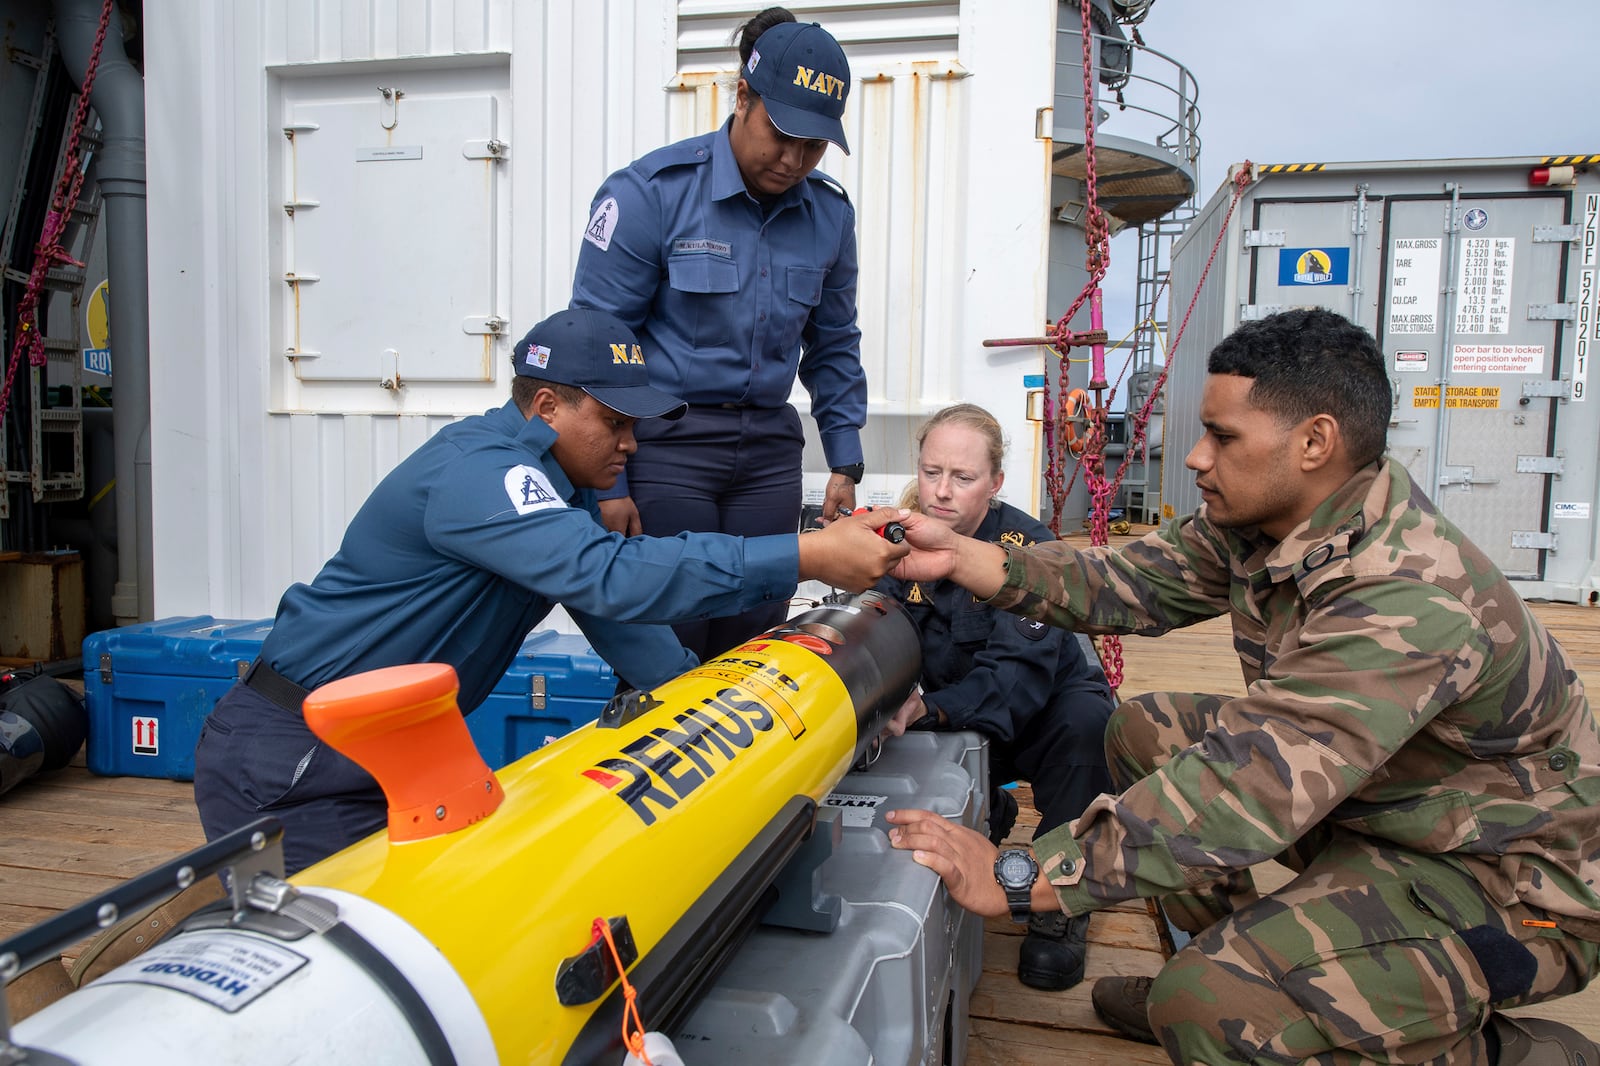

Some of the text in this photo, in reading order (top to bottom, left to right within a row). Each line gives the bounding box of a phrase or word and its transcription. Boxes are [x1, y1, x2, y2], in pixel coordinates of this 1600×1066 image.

[793, 65, 845, 101] NAVY
[1585, 195, 1599, 265] NZDF
[1396, 240, 1438, 249] MAX.GROSS
[1467, 239, 1510, 249] 4.320 kgs.
[1466, 249, 1507, 258] 9.520 lbs.
[1395, 258, 1412, 267] TARE
[1465, 258, 1509, 268] 2.320 kgs.
[1464, 268, 1506, 276] 5.110 lbs.
[1394, 277, 1407, 286] NET
[1464, 277, 1507, 287] 2.000 kgs.
[1463, 286, 1505, 295] 4.410 lbs.
[1469, 296, 1486, 304] 13.5
[1462, 305, 1485, 314] 476.7
[1392, 314, 1433, 323] MAX.GROSS
[1457, 314, 1504, 325] 10.160 kgs.
[1390, 323, 1435, 333] STATIC STORAGE
[1456, 324, 1502, 333] 22.400 lbs.
[1455, 346, 1543, 354] Door bar to be locked
[1454, 354, 1533, 365] open position when
[1453, 364, 1526, 373] entering container
[1415, 387, 1500, 397] STATIC STORAGE ONLY
[1574, 381, 1583, 398] 9
[1414, 398, 1499, 408] EMPTY FOR TRANSPORT
[580, 687, 774, 827] REMUS
[141, 962, 250, 997] HYDROID
